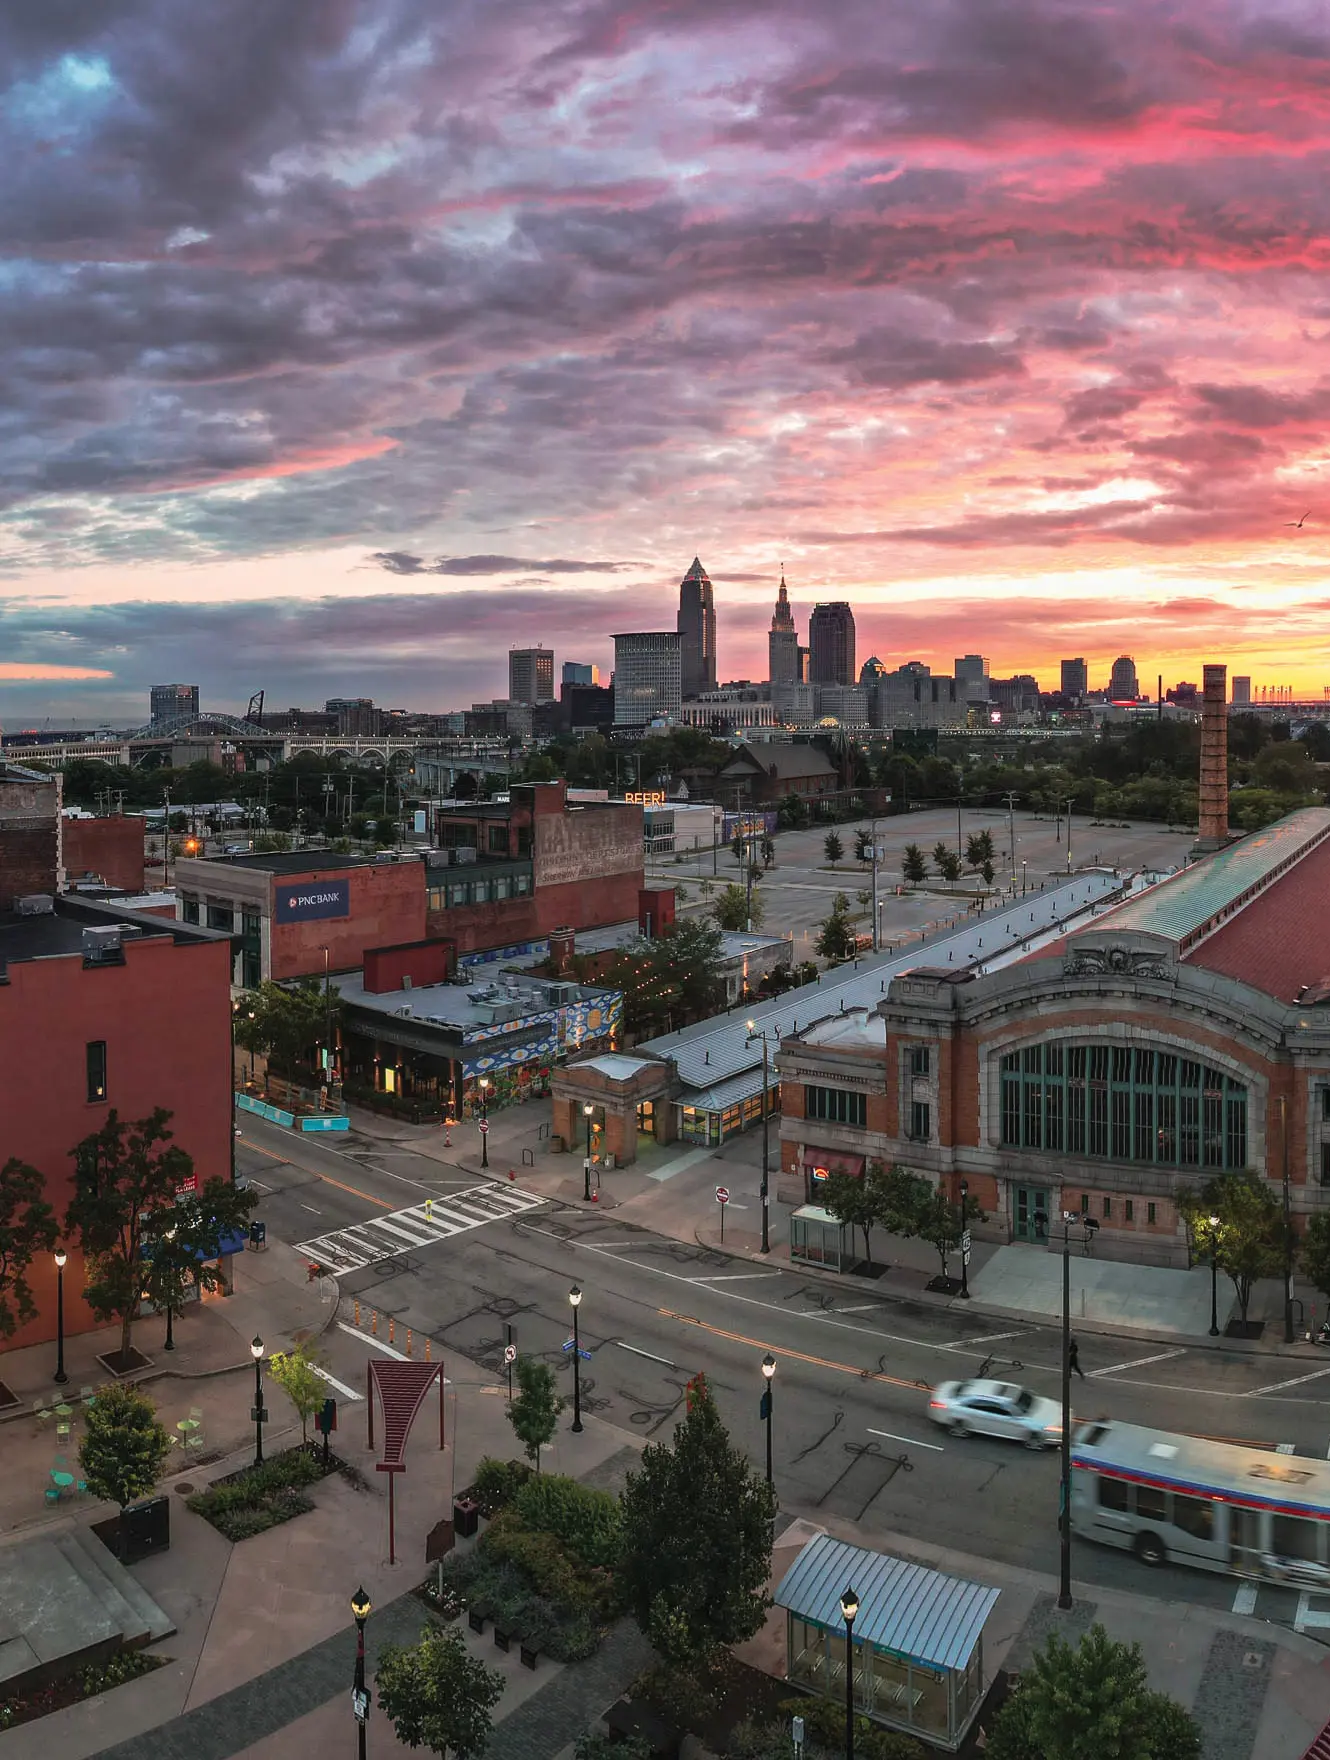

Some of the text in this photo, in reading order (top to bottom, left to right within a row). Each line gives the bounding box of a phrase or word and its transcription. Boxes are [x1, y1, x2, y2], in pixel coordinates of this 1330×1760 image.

[625, 791, 665, 806] BEER!
[298, 892, 340, 906] PNC BANK
